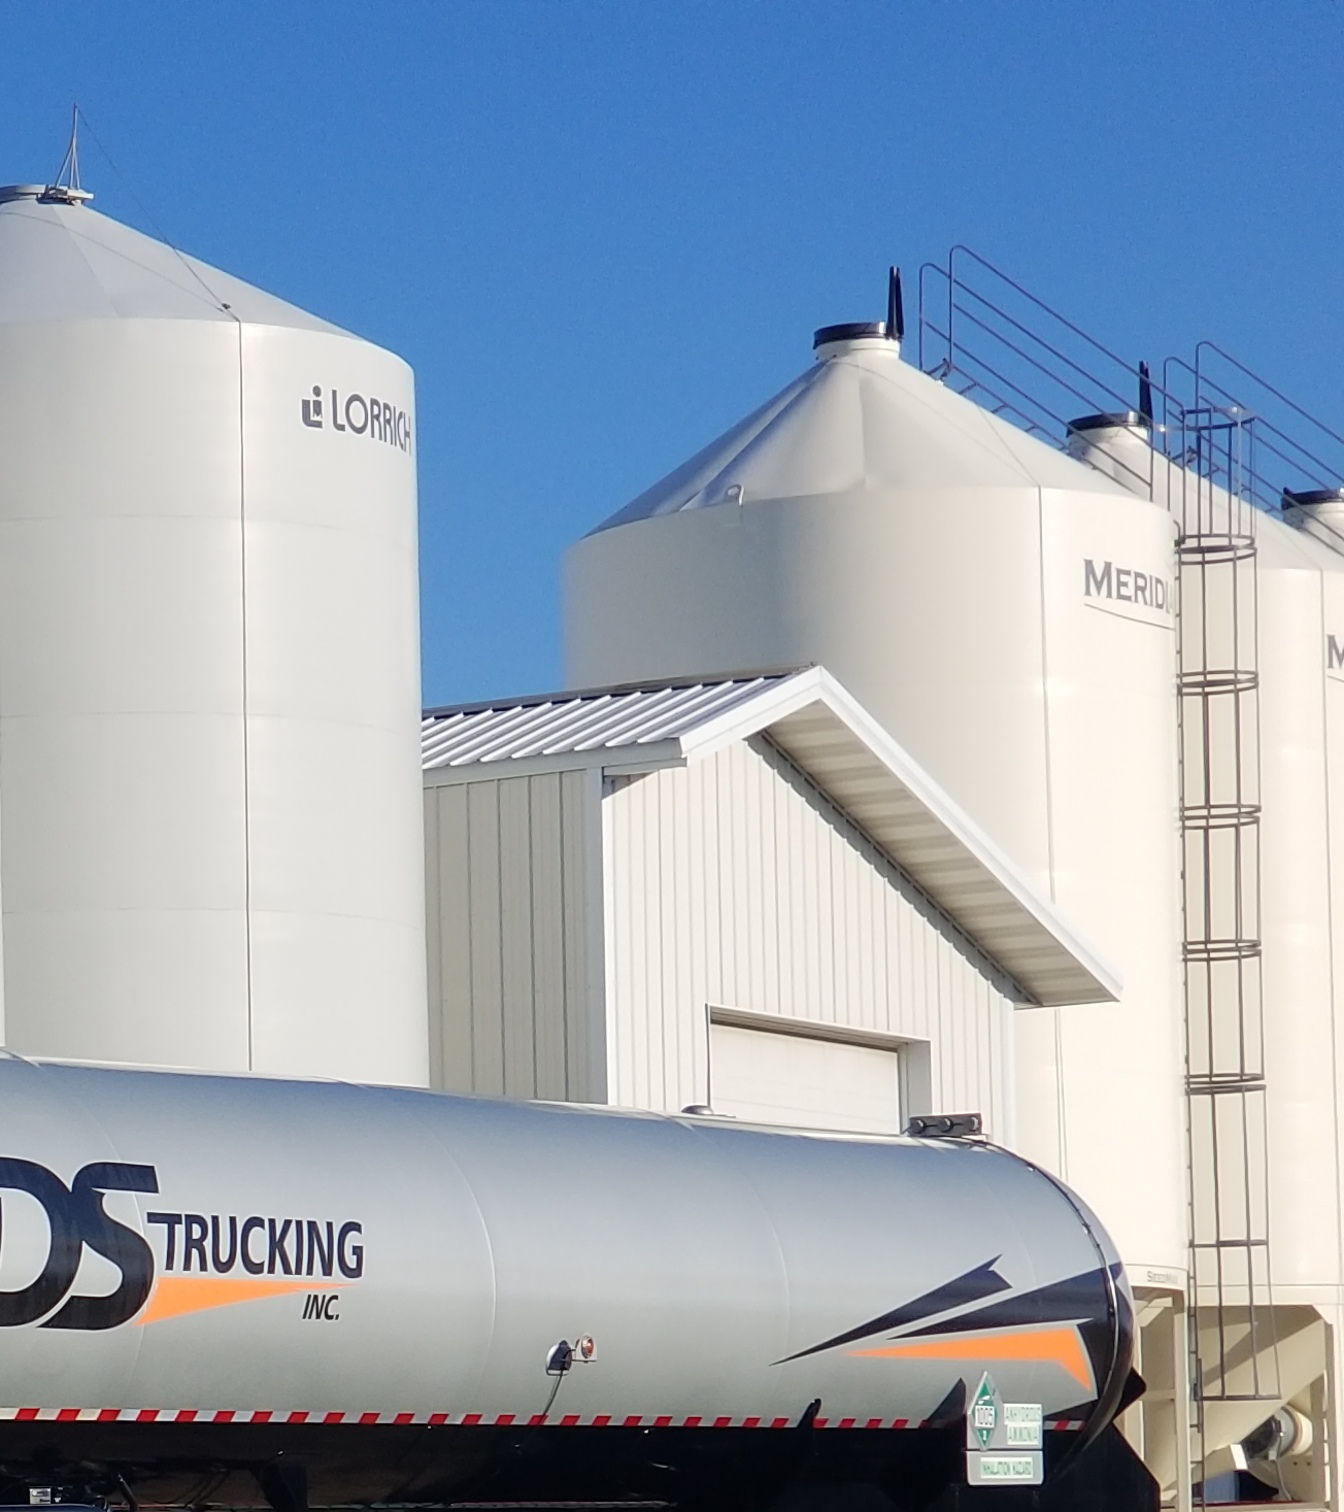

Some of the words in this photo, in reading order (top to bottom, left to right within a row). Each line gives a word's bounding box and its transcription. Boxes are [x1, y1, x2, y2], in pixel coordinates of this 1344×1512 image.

[332, 389, 411, 456] LORRICH
[1083, 559, 1171, 614] MERIDI
[147, 1211, 364, 1279] TRUCKING
[301, 1294, 341, 1321] INC.
